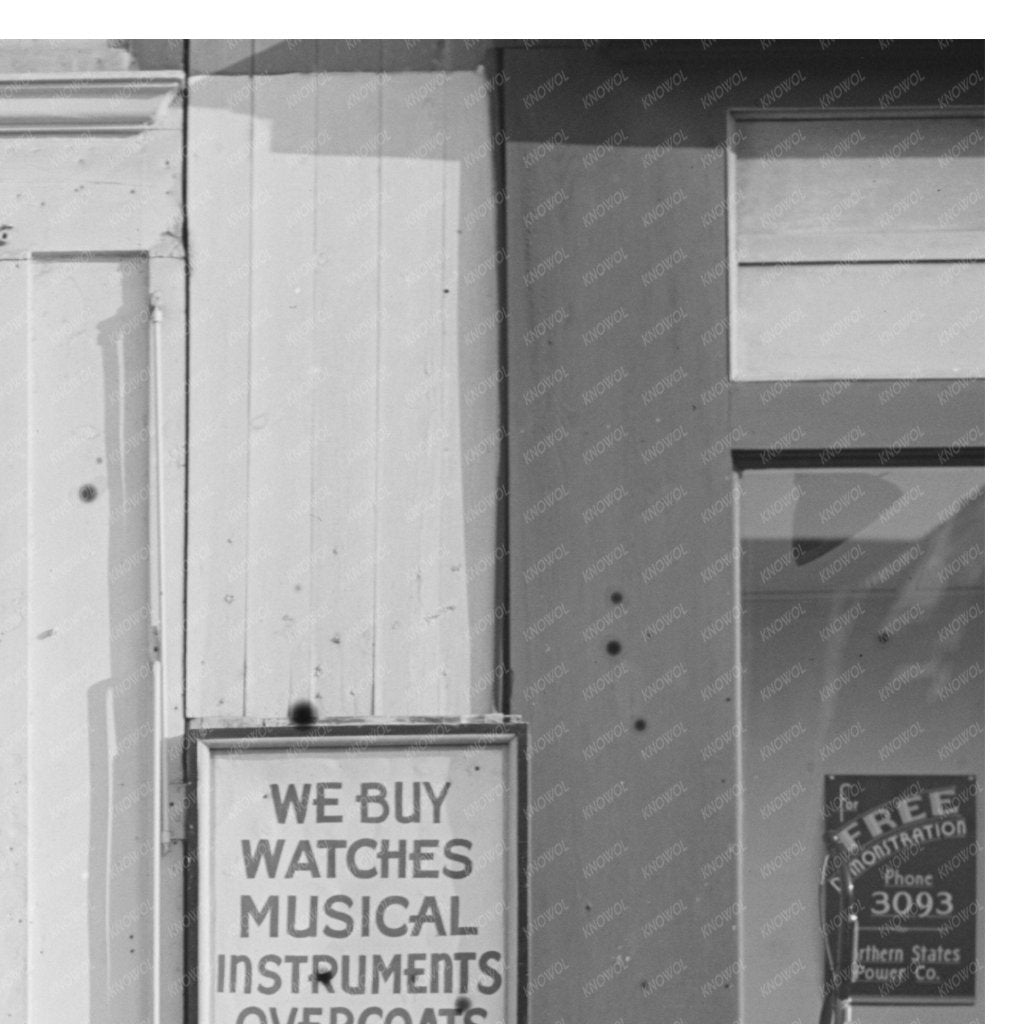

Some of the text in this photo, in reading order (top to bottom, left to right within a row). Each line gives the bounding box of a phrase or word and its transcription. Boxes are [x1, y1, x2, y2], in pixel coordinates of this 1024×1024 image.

[270, 781, 451, 824] WE BUY
[837, 785, 960, 852] FREE
[240, 838, 473, 880] WATCHES
[239, 894, 478, 939] MUSICAL
[870, 891, 954, 918] 3093
[216, 950, 502, 995] INSTRUMENTS
[912, 944, 961, 963] States
[915, 965, 941, 981] Co.
